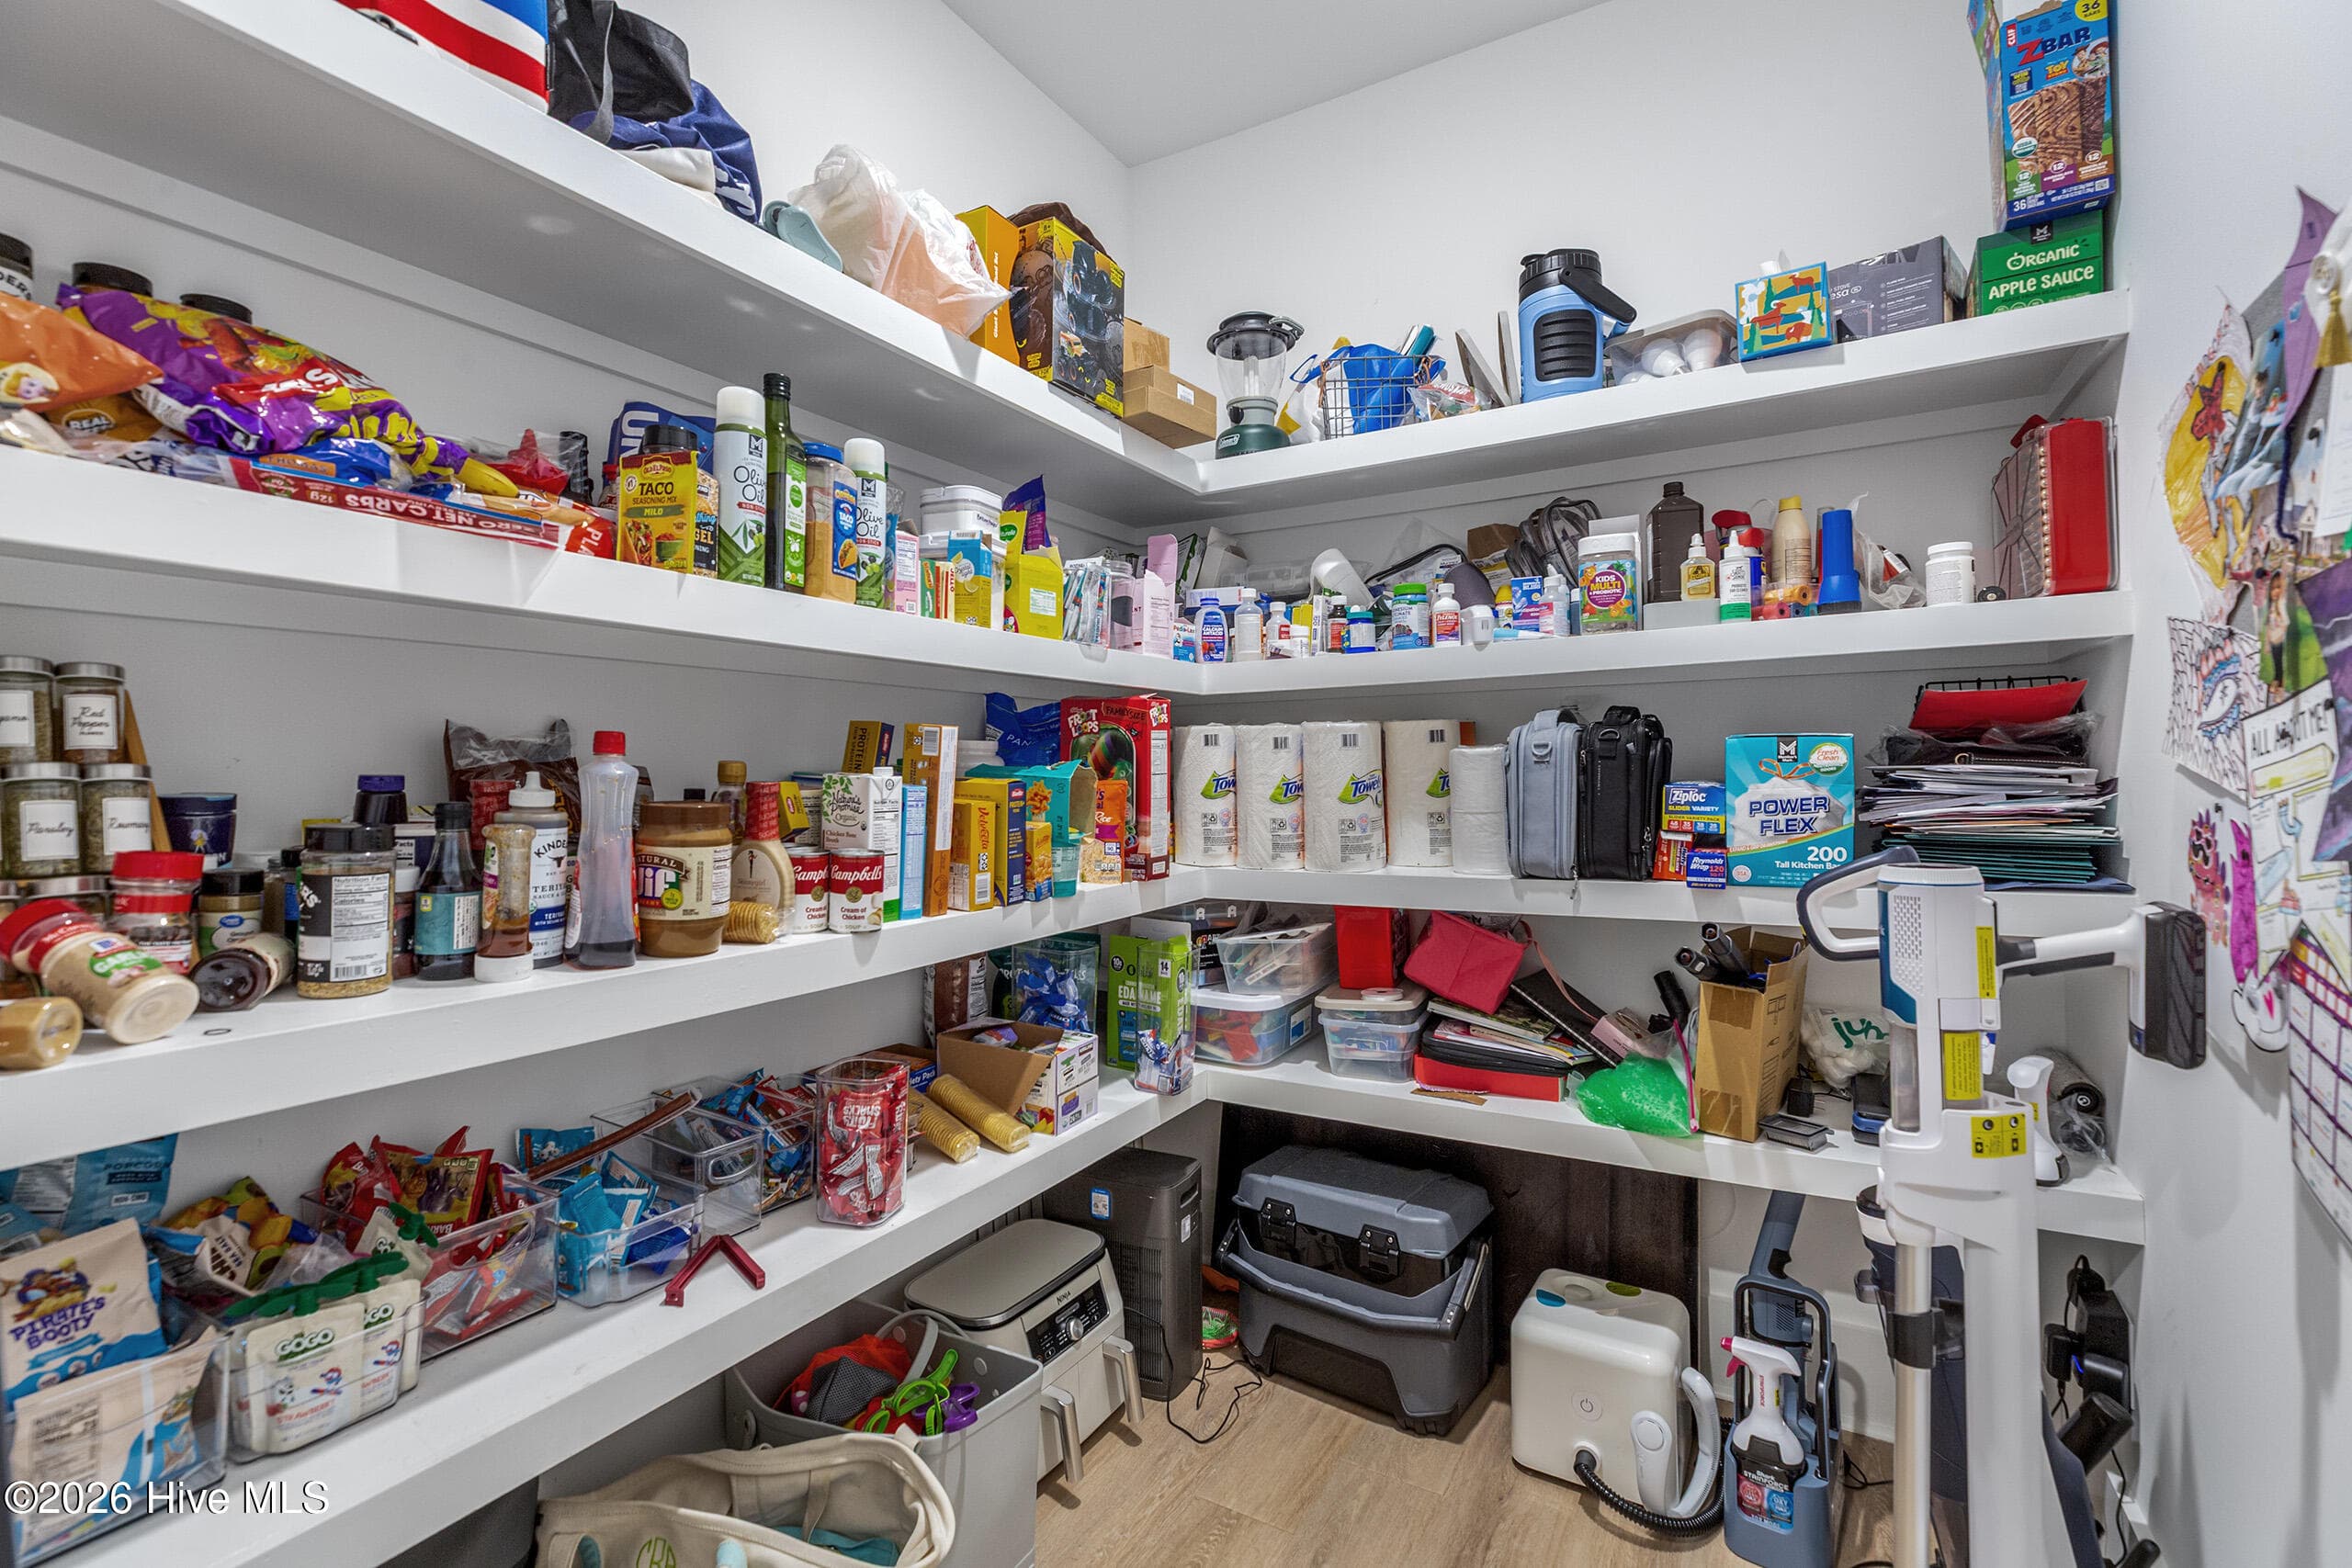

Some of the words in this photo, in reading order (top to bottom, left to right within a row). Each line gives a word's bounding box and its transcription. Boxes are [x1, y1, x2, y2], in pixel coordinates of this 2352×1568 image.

[2082, 1, 2100, 13] 36
[2007, 27, 2016, 46] CLIF
[2087, 152, 2099, 162] 12
[2052, 163, 2064, 171] 12
[2013, 199, 2027, 211] 36
[2007, 243, 2080, 270] ORGANIC
[1988, 277, 2037, 300] APPLE
[2041, 265, 2095, 288] SAUCE
[68, 418, 110, 432] REAL
[734, 466, 767, 487] Oliv
[639, 482, 673, 495] TACO
[742, 484, 764, 505] Oil
[345, 493, 428, 518] CARBS
[632, 497, 665, 505] SEASONING
[433, 510, 474, 526] NET
[644, 507, 662, 516] MILD
[695, 512, 716, 524] thing
[839, 513, 854, 524] TACO
[695, 528, 714, 544] GEL
[1590, 581, 1621, 591] MULTI
[1595, 575, 1616, 583] KIDS
[1068, 709, 1098, 726] FROOT
[1105, 705, 1128, 720] FAMILY
[1151, 714, 1169, 727] LOOPS
[1071, 720, 1100, 738] LOOPS
[2251, 728, 2270, 759] ALL
[1213, 776, 1236, 794] Tow
[1282, 780, 1304, 797] Tow
[831, 791, 862, 806] Nature's
[1672, 790, 1707, 804] Ziploc
[830, 803, 865, 816] Promise
[1749, 795, 1831, 817] POWER
[835, 813, 857, 823] Organic
[977, 806, 989, 854] Velveeta
[1760, 817, 1817, 836] FLEX
[534, 836, 567, 858] KINDE
[1807, 846, 1848, 862] 200
[1692, 856, 1724, 864] Reynolds
[1792, 861, 1824, 869] Kitchen
[1826, 862, 1840, 870] Ba
[831, 864, 882, 883] Campbell's
[1160, 961, 1169, 972] 14
[922, 1070, 936, 1081] Pack
[1056, 1291, 1071, 1305] NINJA
[9, 1296, 107, 1342] PIRATE'S
[26, 1313, 96, 1350] BOOTY
